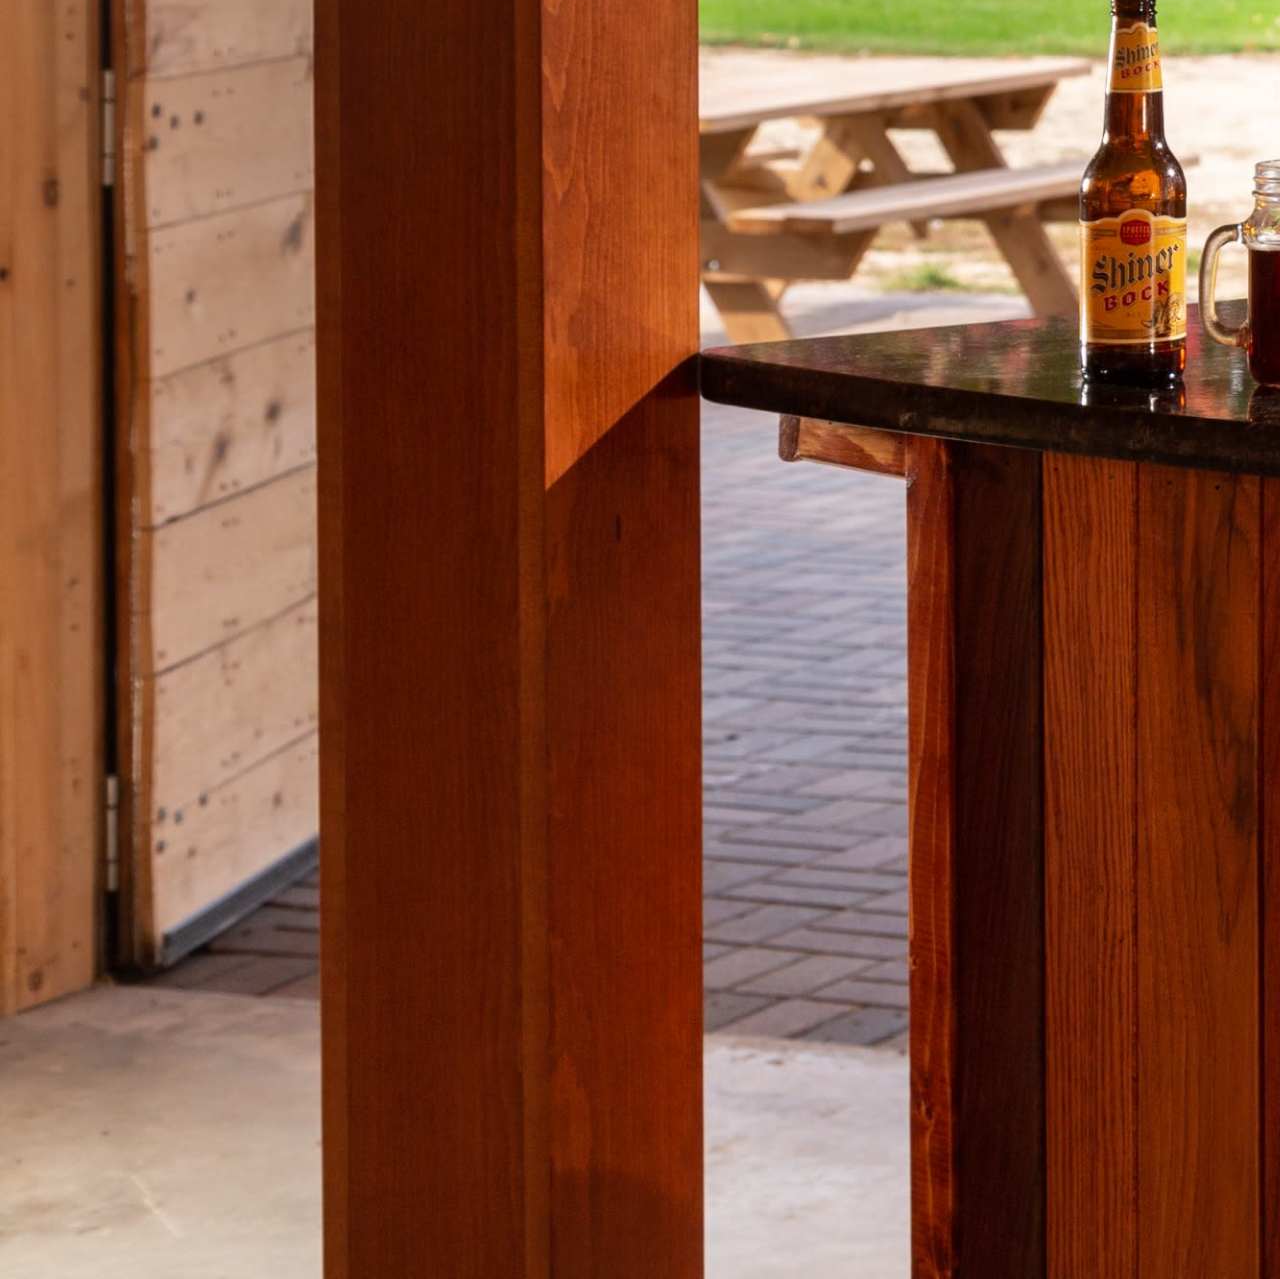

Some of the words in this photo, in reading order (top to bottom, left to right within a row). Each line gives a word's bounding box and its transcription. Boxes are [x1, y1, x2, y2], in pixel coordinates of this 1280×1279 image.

[1121, 61, 1160, 79] BOCK
[1091, 246, 1173, 293] Shiner
[1104, 279, 1169, 311] BOCK
